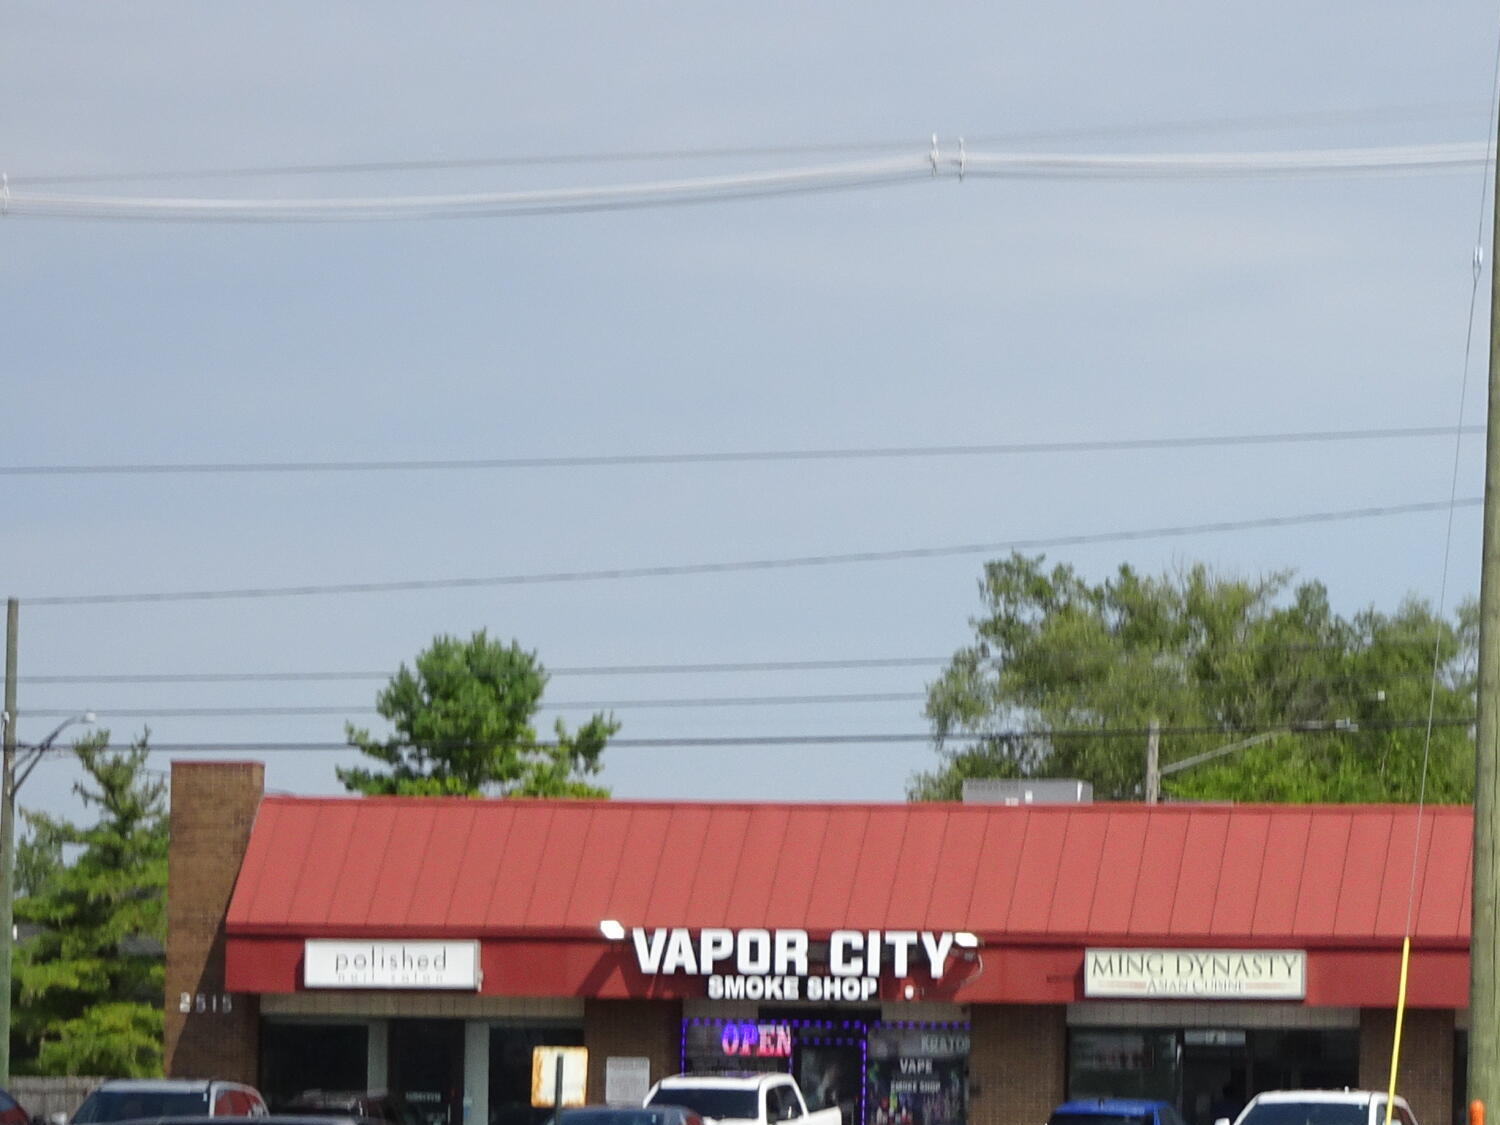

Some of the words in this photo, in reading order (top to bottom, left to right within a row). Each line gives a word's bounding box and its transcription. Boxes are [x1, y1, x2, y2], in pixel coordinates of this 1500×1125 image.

[336, 945, 447, 974] polished
[632, 927, 808, 976] VAPOR
[830, 930, 954, 979] CITY
[1092, 953, 1164, 977] MING
[1176, 953, 1298, 978] DYNASTY
[708, 975, 800, 1000] SMOKE
[806, 976, 878, 1000] SHOP
[721, 1024, 792, 1058] OPEN
[899, 1058, 933, 1075] VAPE
